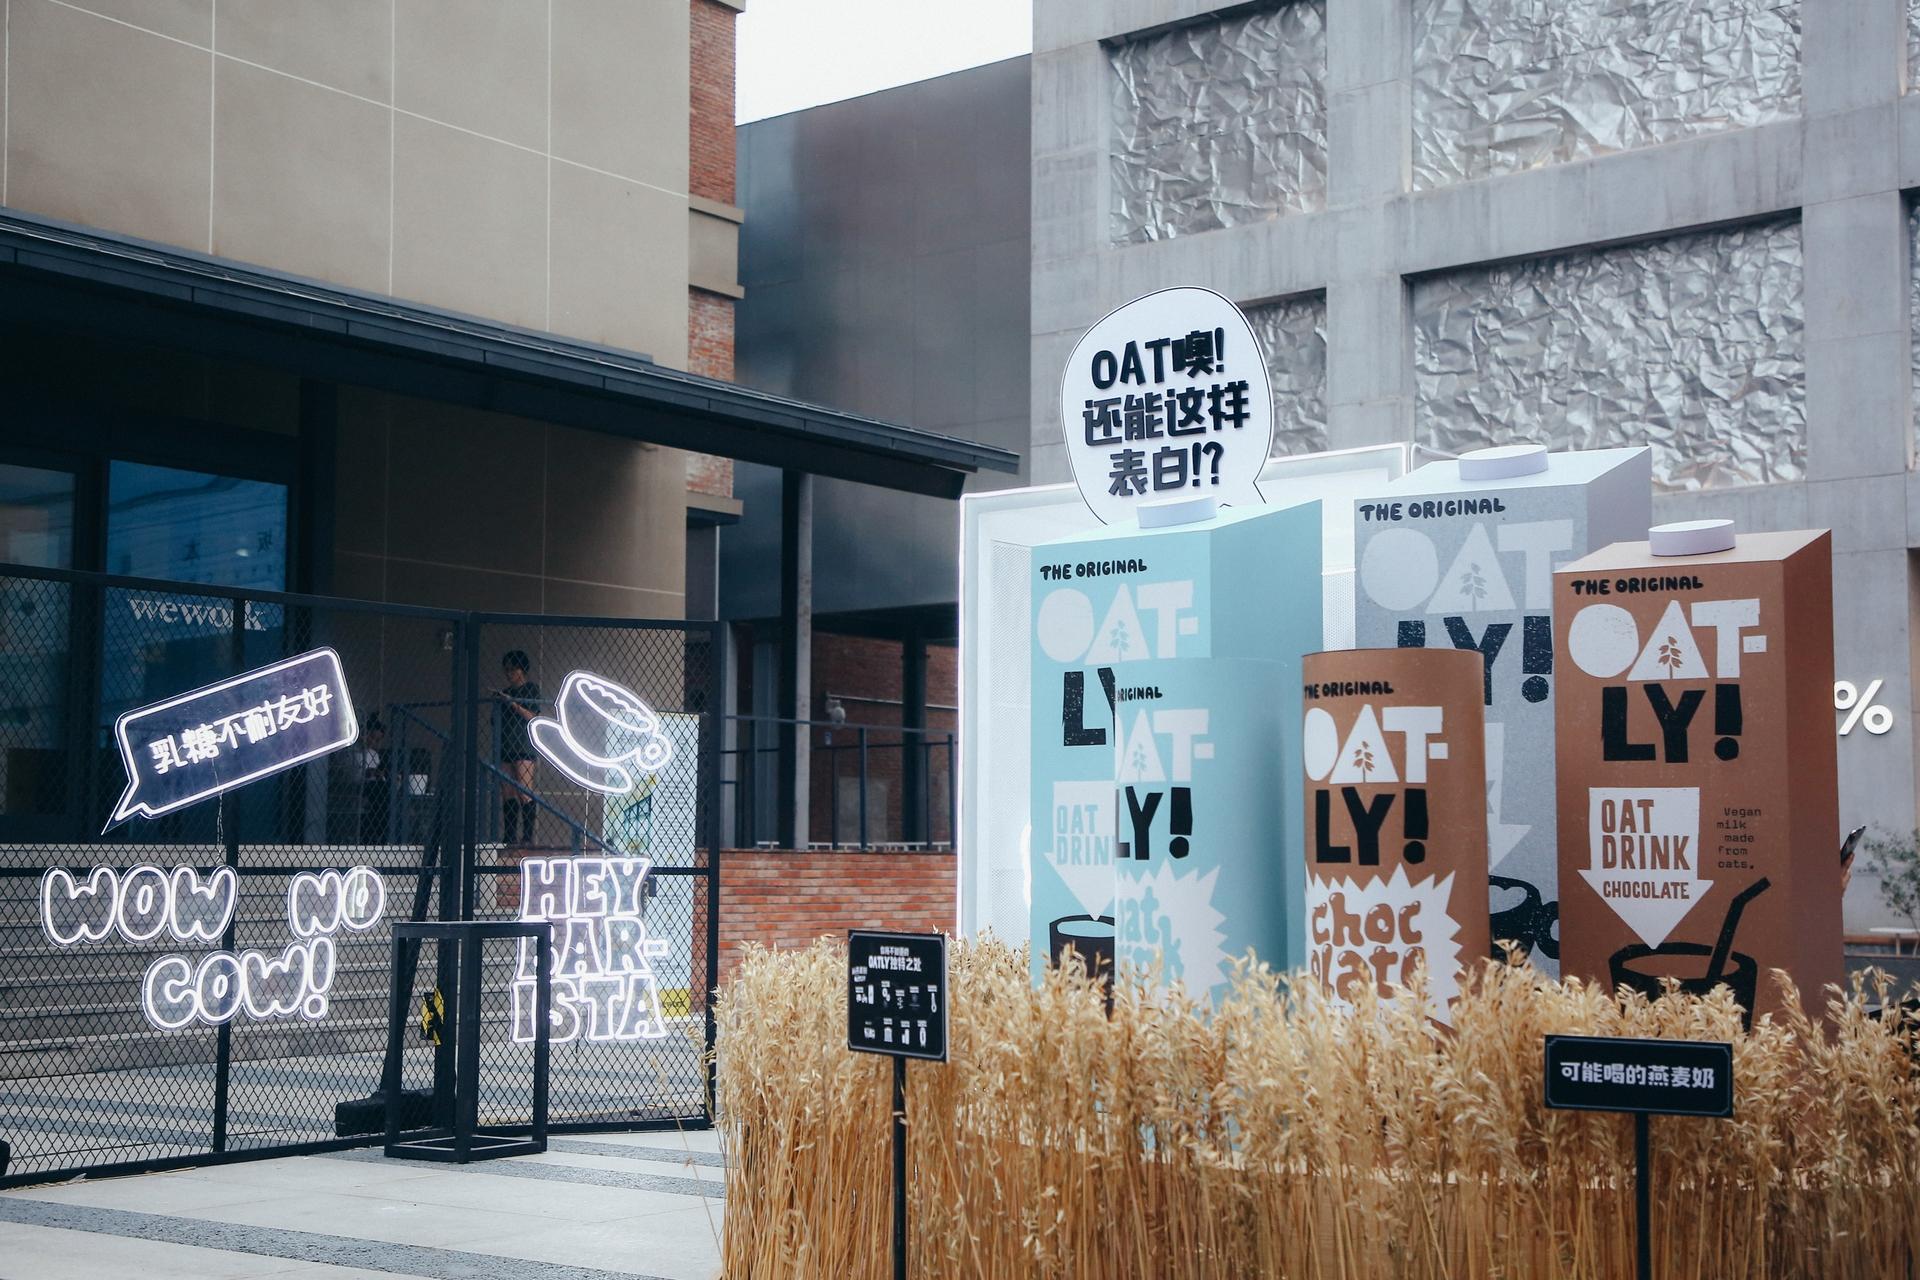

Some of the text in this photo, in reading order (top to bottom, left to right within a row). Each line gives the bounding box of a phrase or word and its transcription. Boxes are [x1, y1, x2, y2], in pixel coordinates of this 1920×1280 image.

[1091, 327, 1226, 391] OAT噢!
[1083, 380, 1250, 446] 还能这样
[1108, 441, 1225, 497] 表白!?
[1359, 498, 1506, 522] THE ORIGINAL
[1040, 558, 1148, 581] THE ORIGINAL
[1361, 519, 1574, 614] OAT
[1570, 575, 1704, 596] THE ORIGINAL
[127, 599, 267, 632] wewok
[1322, 681, 1394, 698] ORIGINAL
[148, 684, 333, 775] 乳糖不耐友好
[1601, 683, 1744, 764] LY!
[1056, 803, 1098, 834] OAT
[1315, 788, 1429, 866] LY!
[1601, 799, 1655, 834] OAT
[1716, 819, 1747, 830] milk
[1724, 807, 1762, 818] Vegan
[1056, 835, 1115, 867] DRIN
[1602, 835, 1691, 871] DRINK
[1718, 845, 1748, 856] from
[1724, 833, 1755, 843] made
[1718, 859, 1755, 870] oats.
[43, 865, 386, 946] WOW NO
[522, 858, 652, 919] HEY
[1603, 880, 1690, 900] CHOCOLATE
[1312, 891, 1423, 948] choc
[144, 936, 336, 1029] COW!
[511, 974, 668, 1042] ISTA
[1560, 1061, 1716, 1089] 可能喝的燕麦奶
